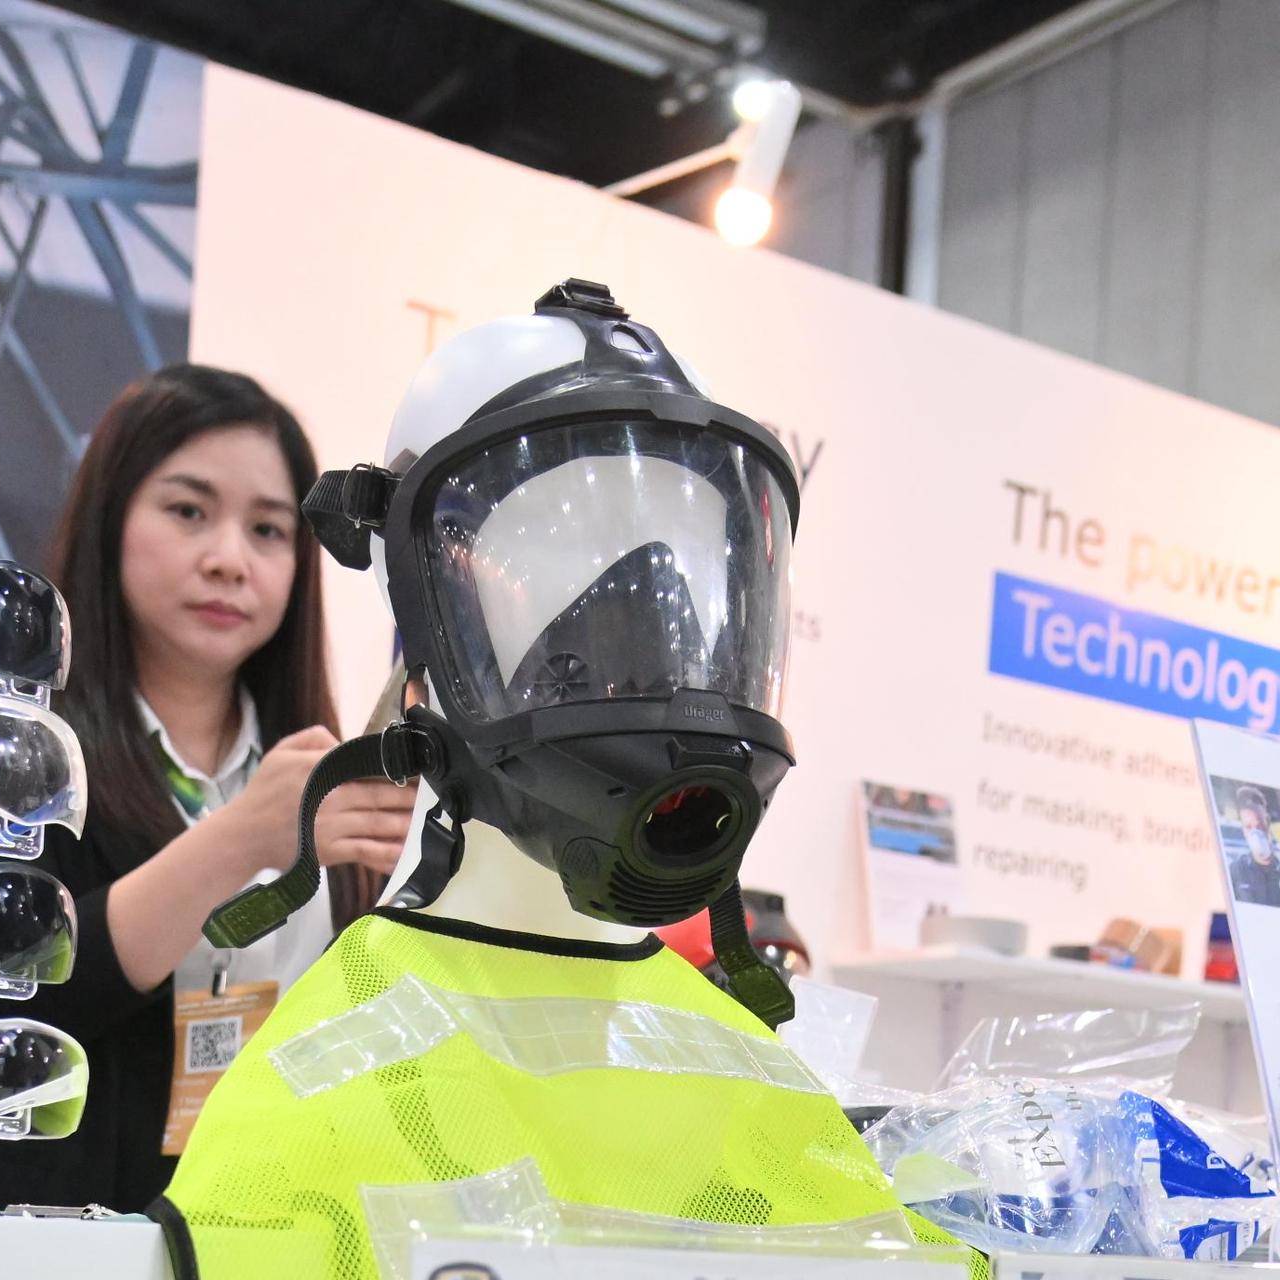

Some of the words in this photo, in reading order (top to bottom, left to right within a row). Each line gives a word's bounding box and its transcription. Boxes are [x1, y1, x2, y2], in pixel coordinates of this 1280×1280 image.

[1003, 479, 1105, 568] The
[982, 711, 1115, 768] Innovative
[977, 778, 1013, 813] for
[1023, 794, 1130, 844] masking,
[973, 845, 1089, 893] repairing
